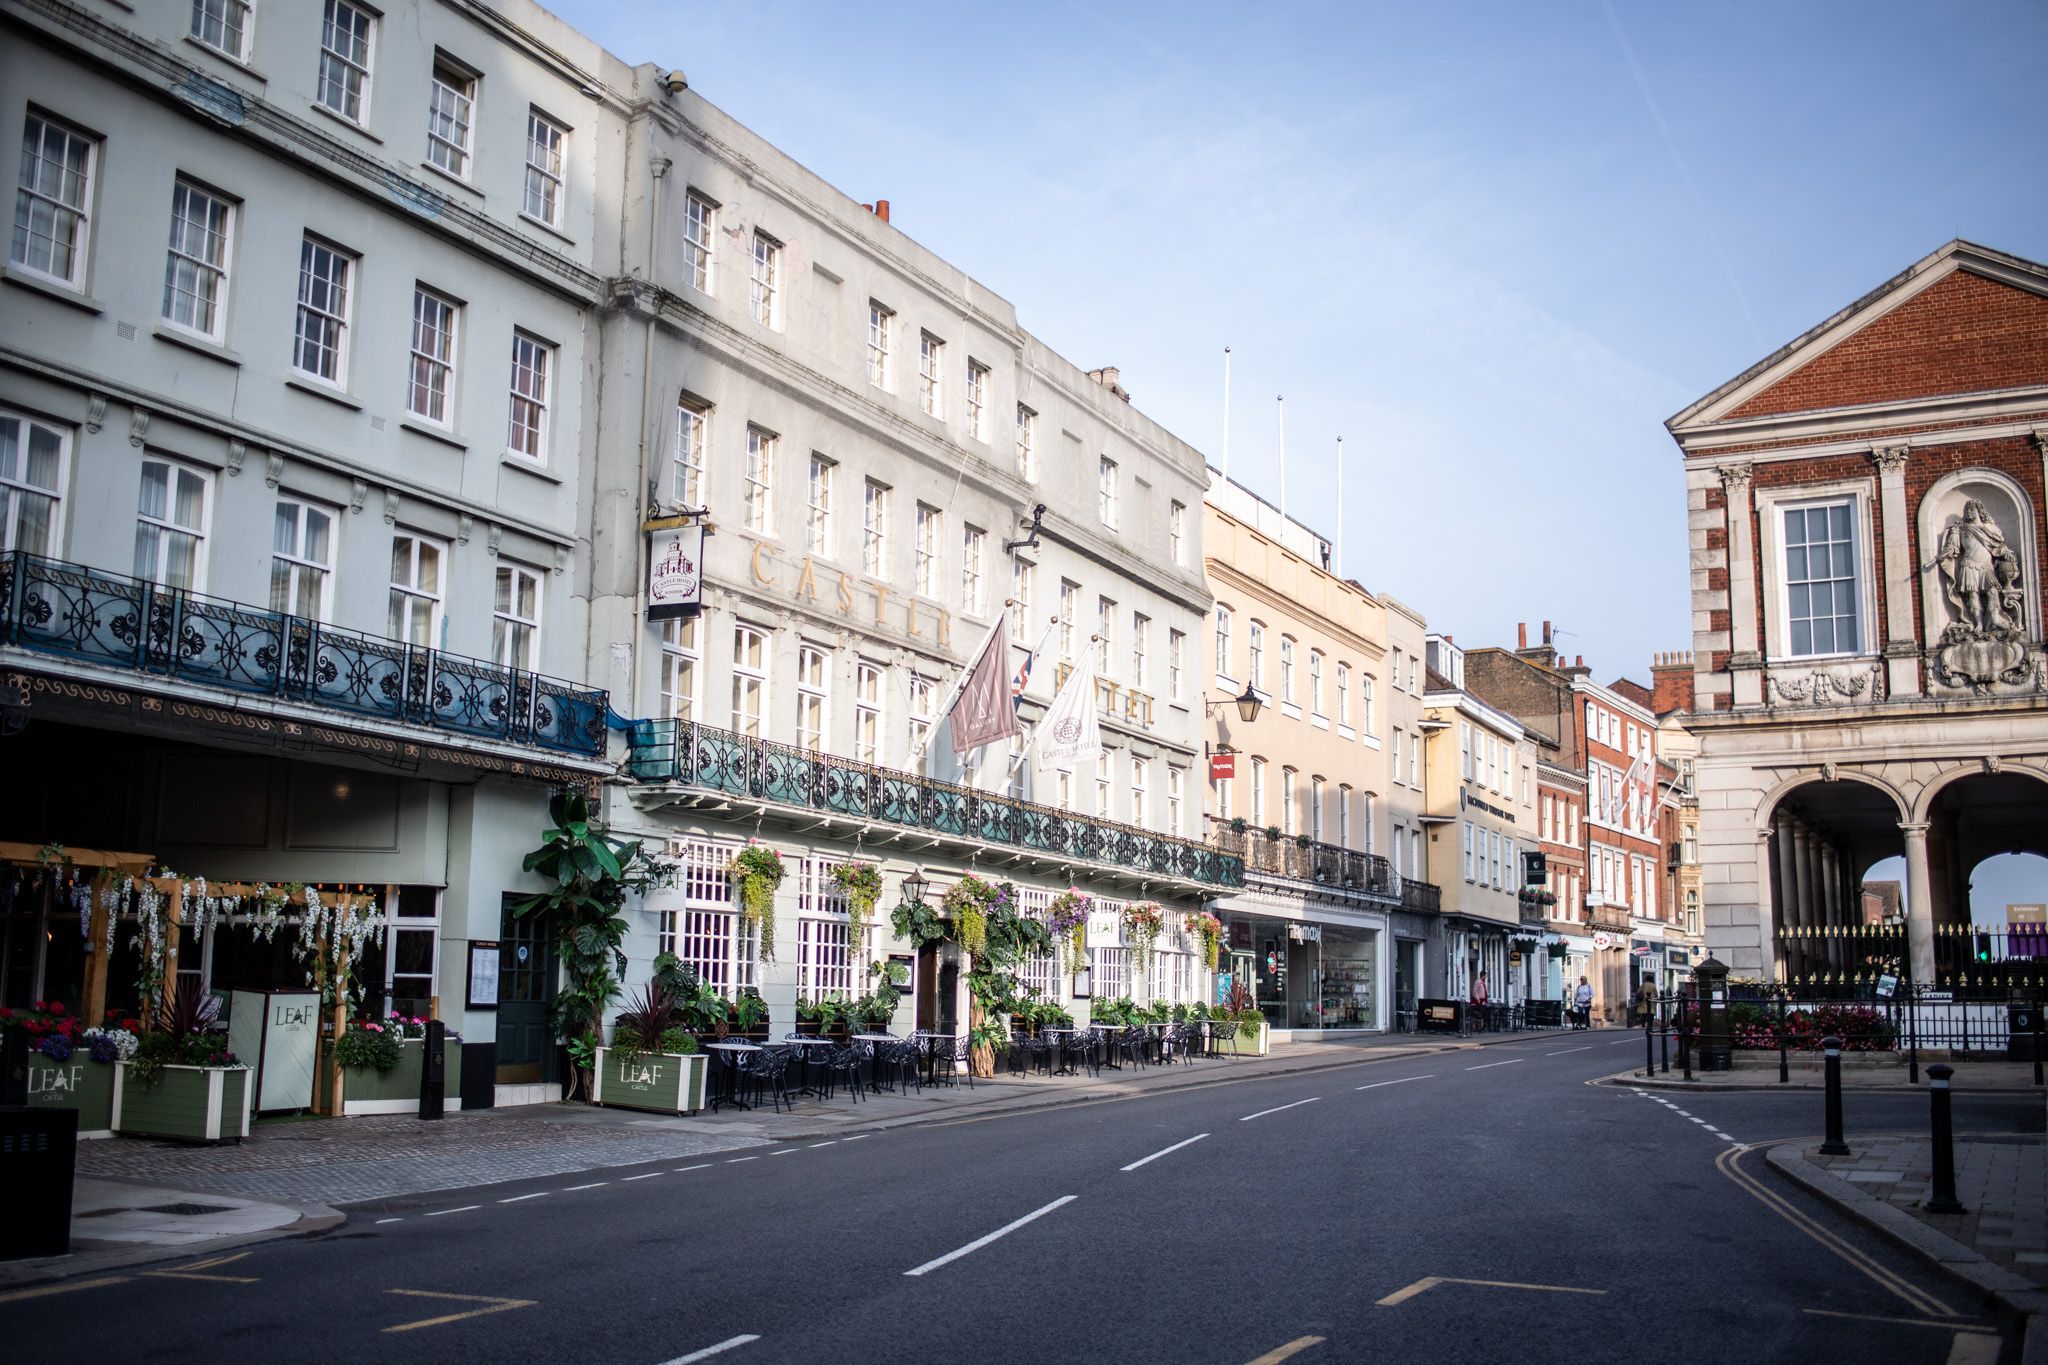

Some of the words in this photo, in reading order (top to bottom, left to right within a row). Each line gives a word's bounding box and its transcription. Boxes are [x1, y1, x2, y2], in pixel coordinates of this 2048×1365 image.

[655, 578, 675, 588] CASTLE
[752, 541, 950, 648] CASTLE
[1058, 662, 1154, 725] HTEL
[1090, 921, 1117, 935] LEAF
[275, 1005, 314, 1026] LEAF
[27, 1065, 84, 1094] LEAF
[621, 1062, 663, 1086] LEAF
